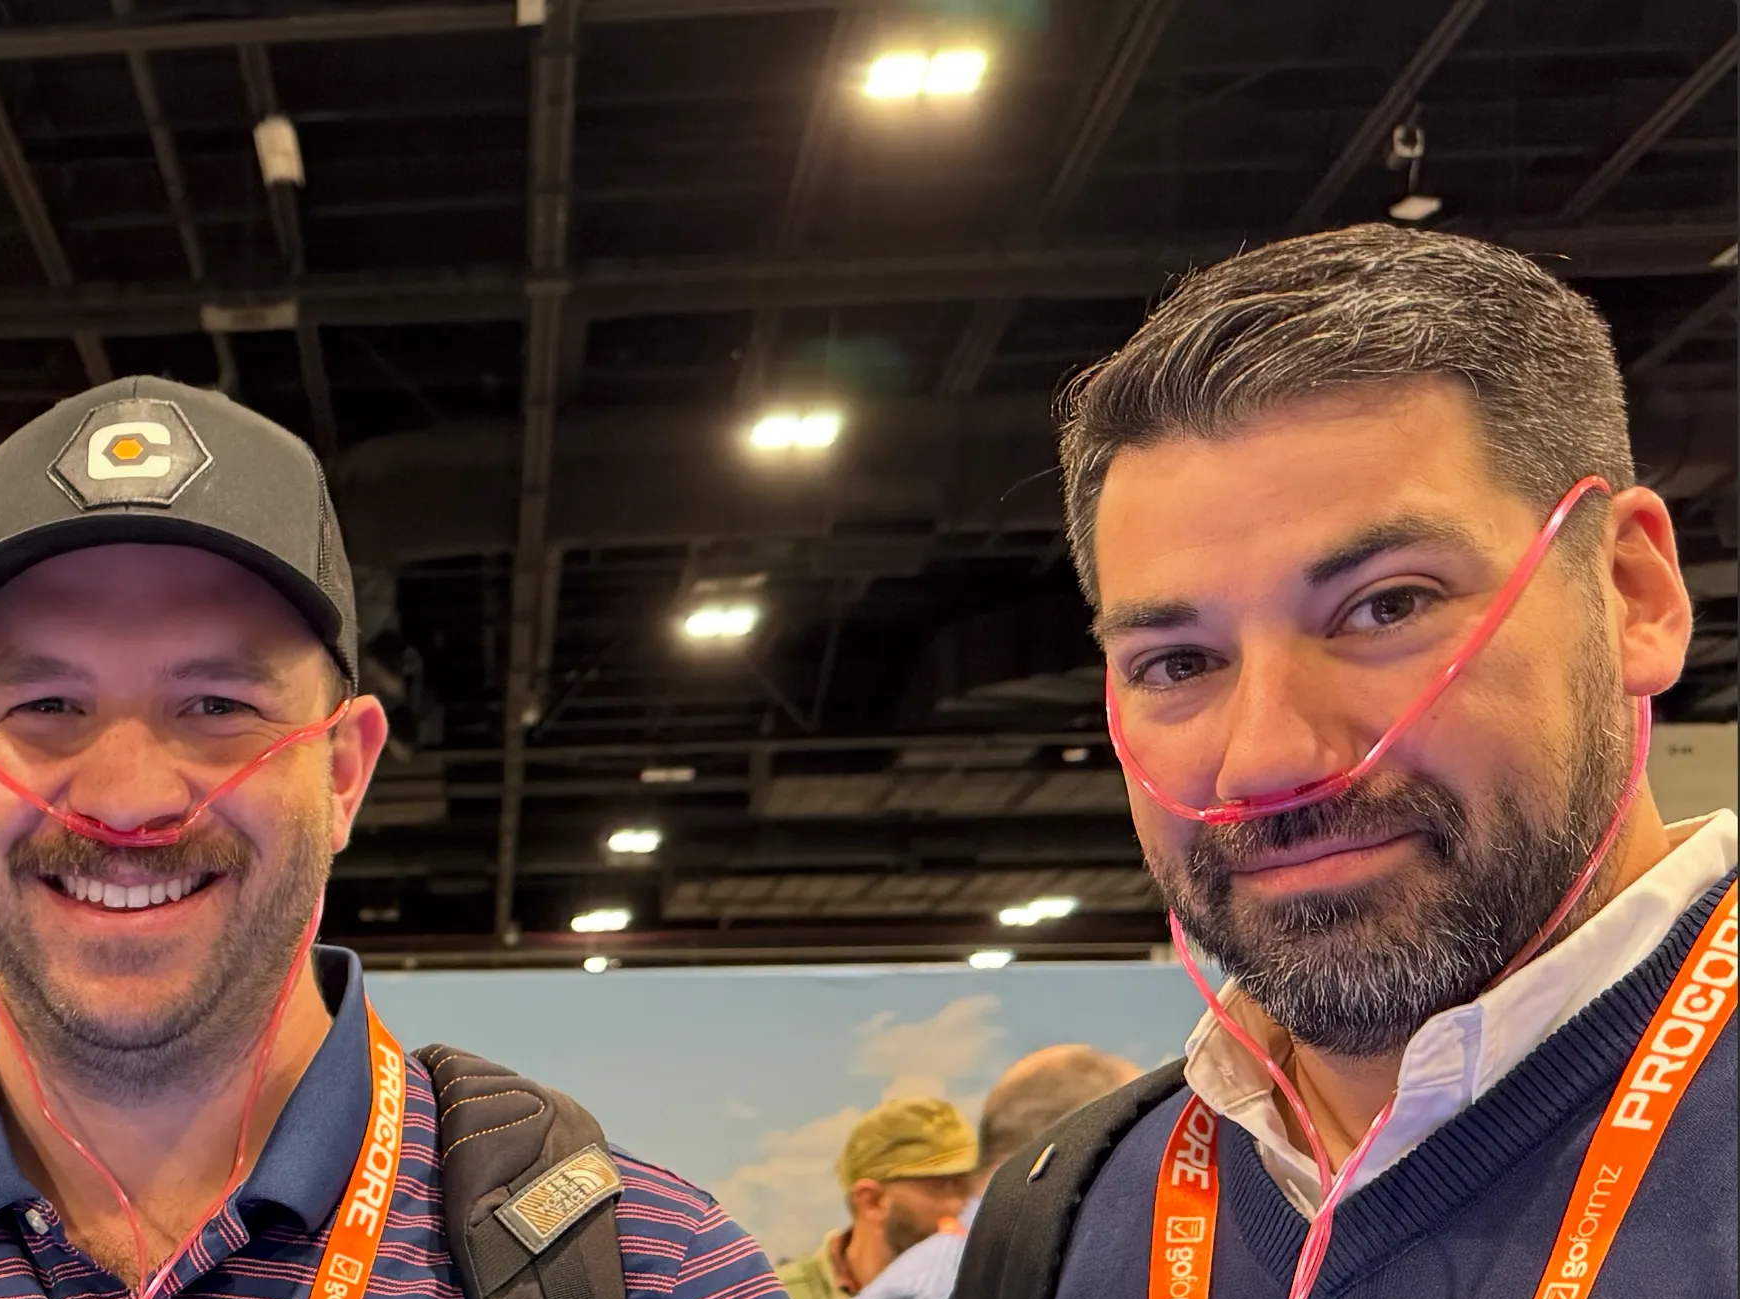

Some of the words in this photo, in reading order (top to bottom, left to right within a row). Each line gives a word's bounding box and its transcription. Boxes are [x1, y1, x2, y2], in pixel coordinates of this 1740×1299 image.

[345, 1042, 403, 1238] PROCORE
[1561, 1164, 1623, 1279] goformz
[1611, 899, 1738, 1132] PROCOR
